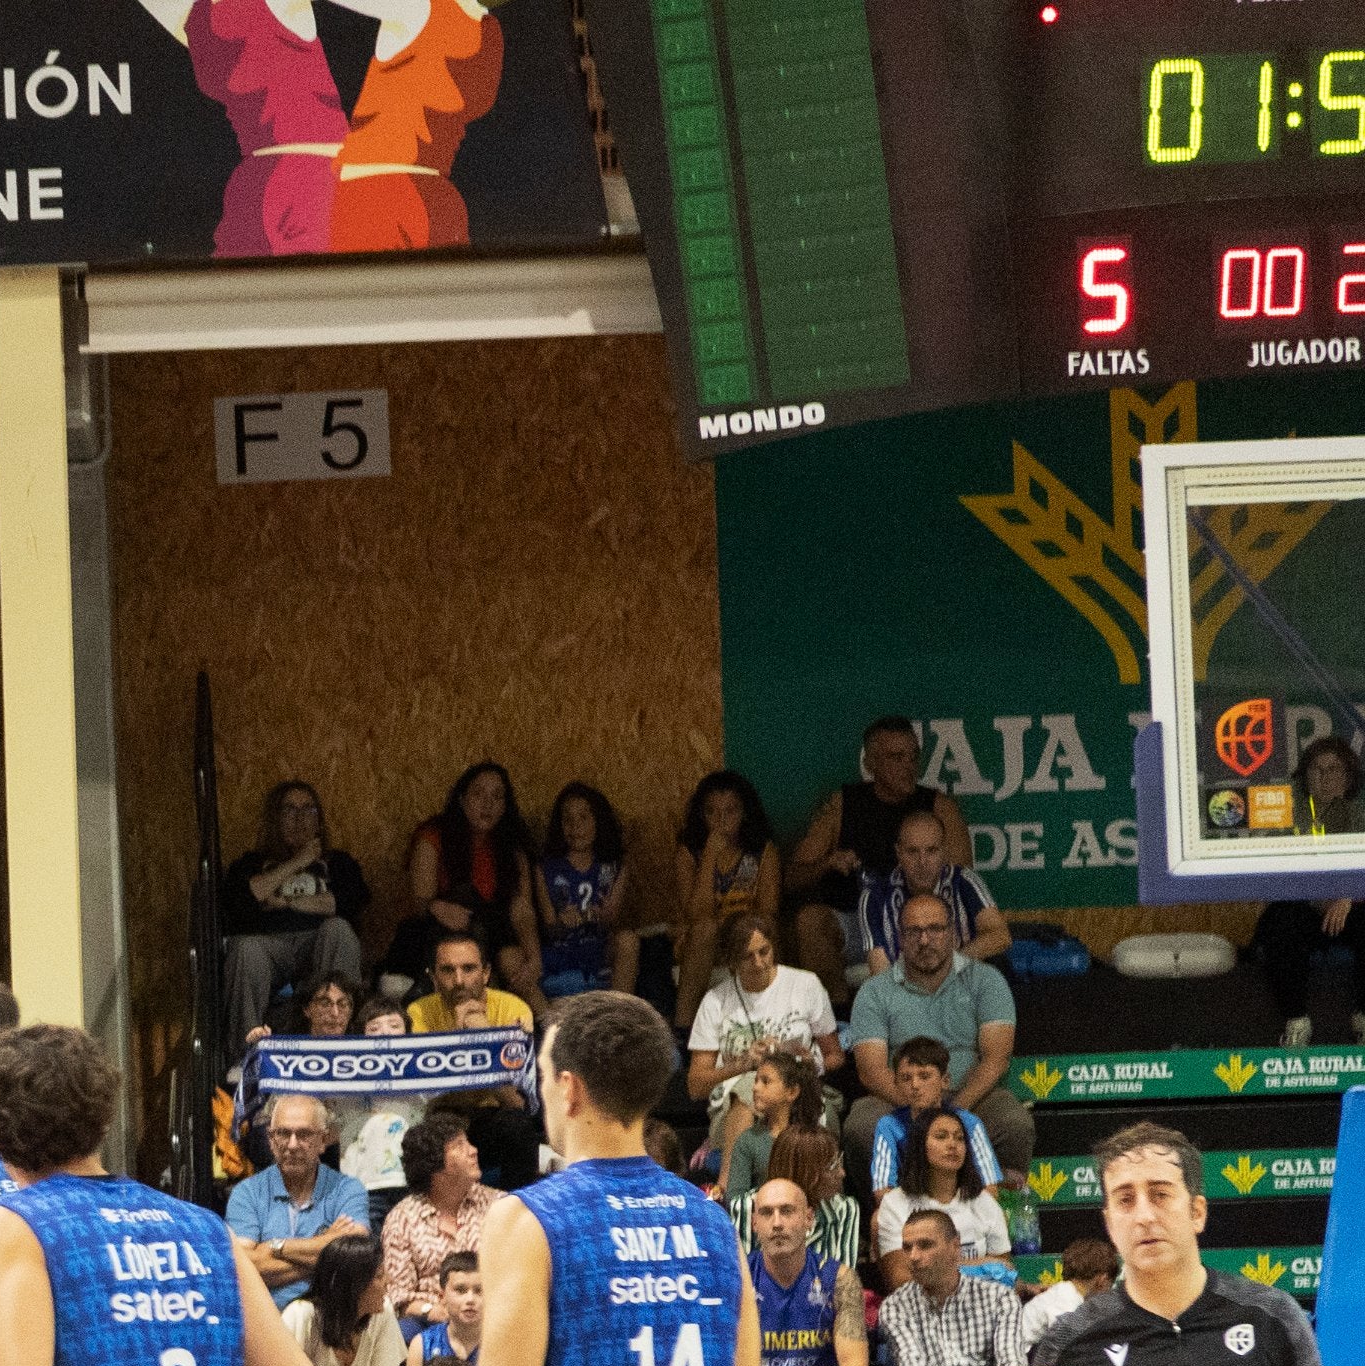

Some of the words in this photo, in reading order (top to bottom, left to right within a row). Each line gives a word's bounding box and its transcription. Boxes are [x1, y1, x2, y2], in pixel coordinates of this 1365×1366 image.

[1081, 247, 1129, 333] 5
[1219, 246, 1305, 318] 00
[1067, 348, 1150, 377] FALTAS
[1247, 336, 1362, 368] JUGADOR
[698, 401, 826, 440] MONDO
[233, 402, 282, 475] F
[320, 400, 370, 470] 5
[861, 711, 1107, 801] AJA
[970, 822, 1045, 872] DE
[269, 1054, 329, 1077] YO
[331, 1052, 413, 1079] SOY
[416, 1049, 493, 1073] OCB
[1067, 1064, 1110, 1081] CAJA
[1113, 1062, 1173, 1080] RURAL
[1262, 1058, 1307, 1075] CAJA
[1308, 1054, 1365, 1073] RURAL
[1070, 1083, 1086, 1095] DE
[1265, 1077, 1280, 1088] DE
[1073, 1166, 1097, 1183] CA
[1271, 1159, 1315, 1176] CAJA
[1274, 1178, 1290, 1189] DE
[623, 1194, 687, 1210] Enerthy
[609, 1226, 672, 1262] SANZ
[670, 1223, 709, 1259] M.
[105, 1235, 187, 1282] LÓPEZ
[1290, 1257, 1322, 1274] CAJ
[763, 1329, 830, 1351] IMERKA
